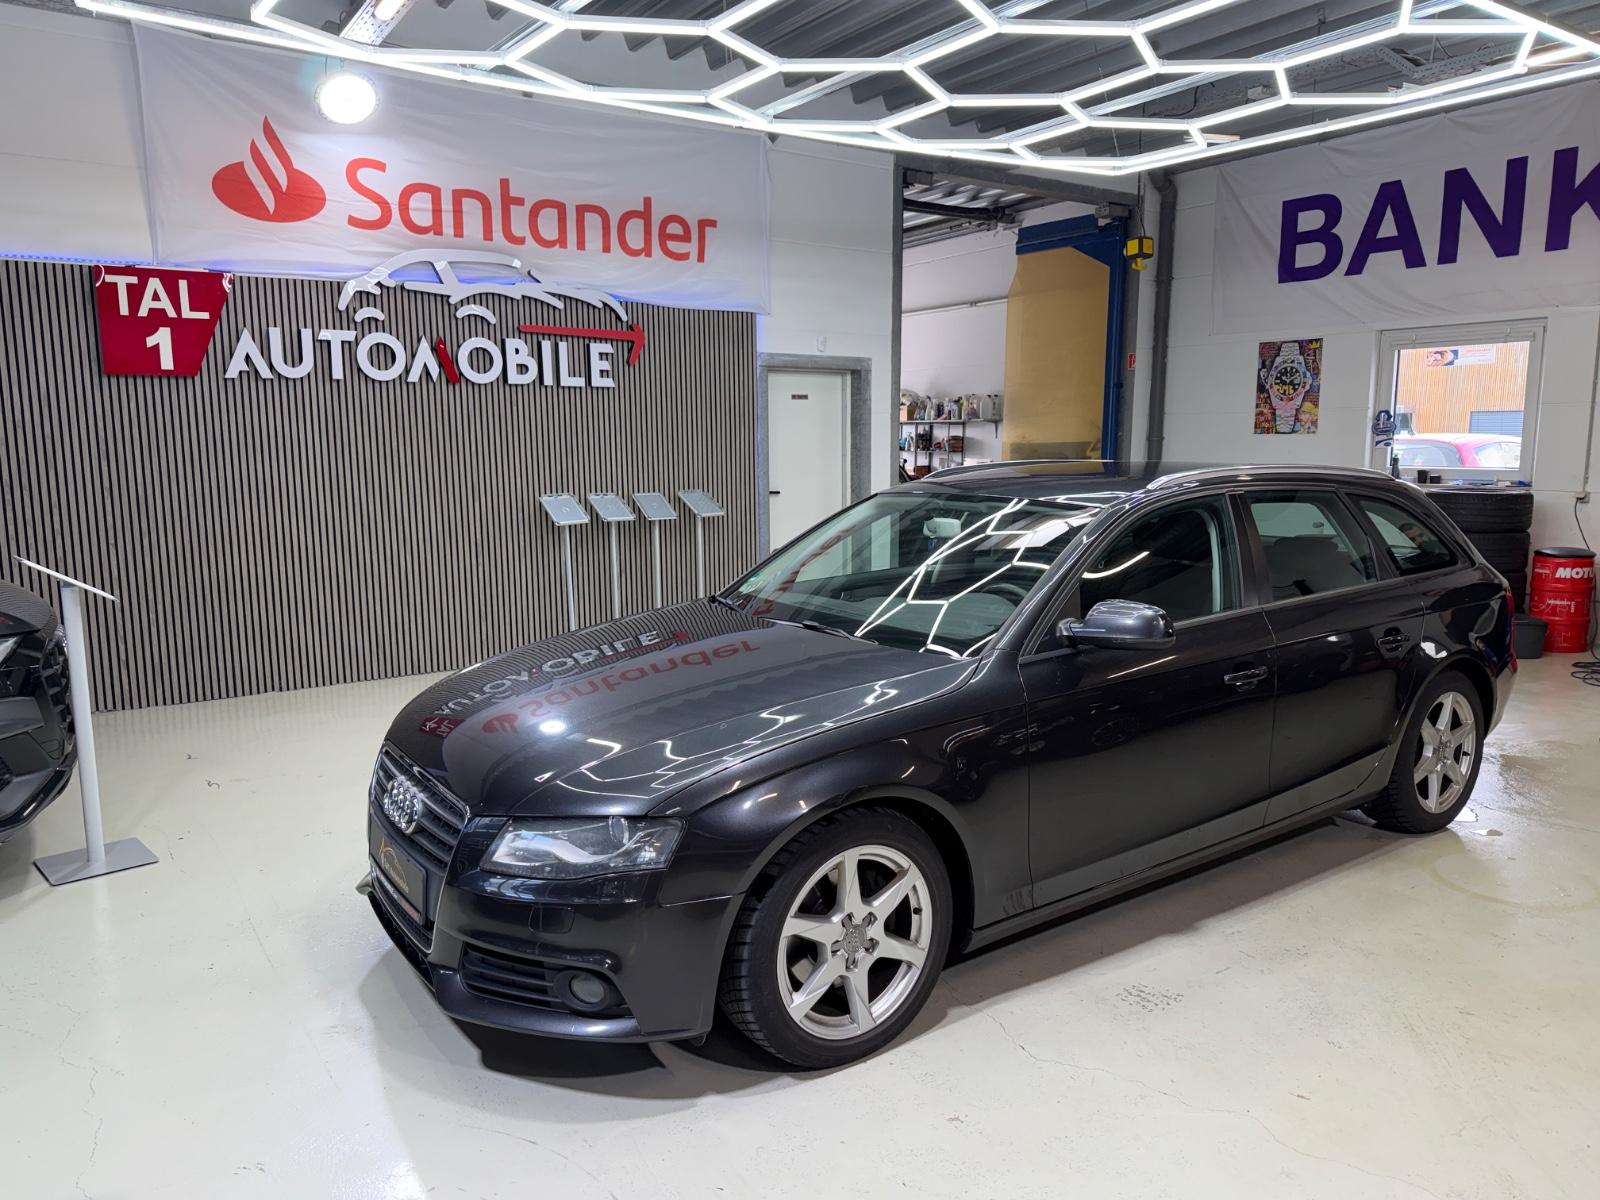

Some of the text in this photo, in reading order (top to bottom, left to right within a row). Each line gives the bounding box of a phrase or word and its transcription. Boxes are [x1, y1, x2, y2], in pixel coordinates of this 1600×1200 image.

[345, 157, 718, 263] Santander
[1278, 146, 1600, 284] BANK
[104, 275, 210, 320] TAL
[146, 326, 174, 371] 1
[224, 326, 616, 388] AUTOMOBILE
